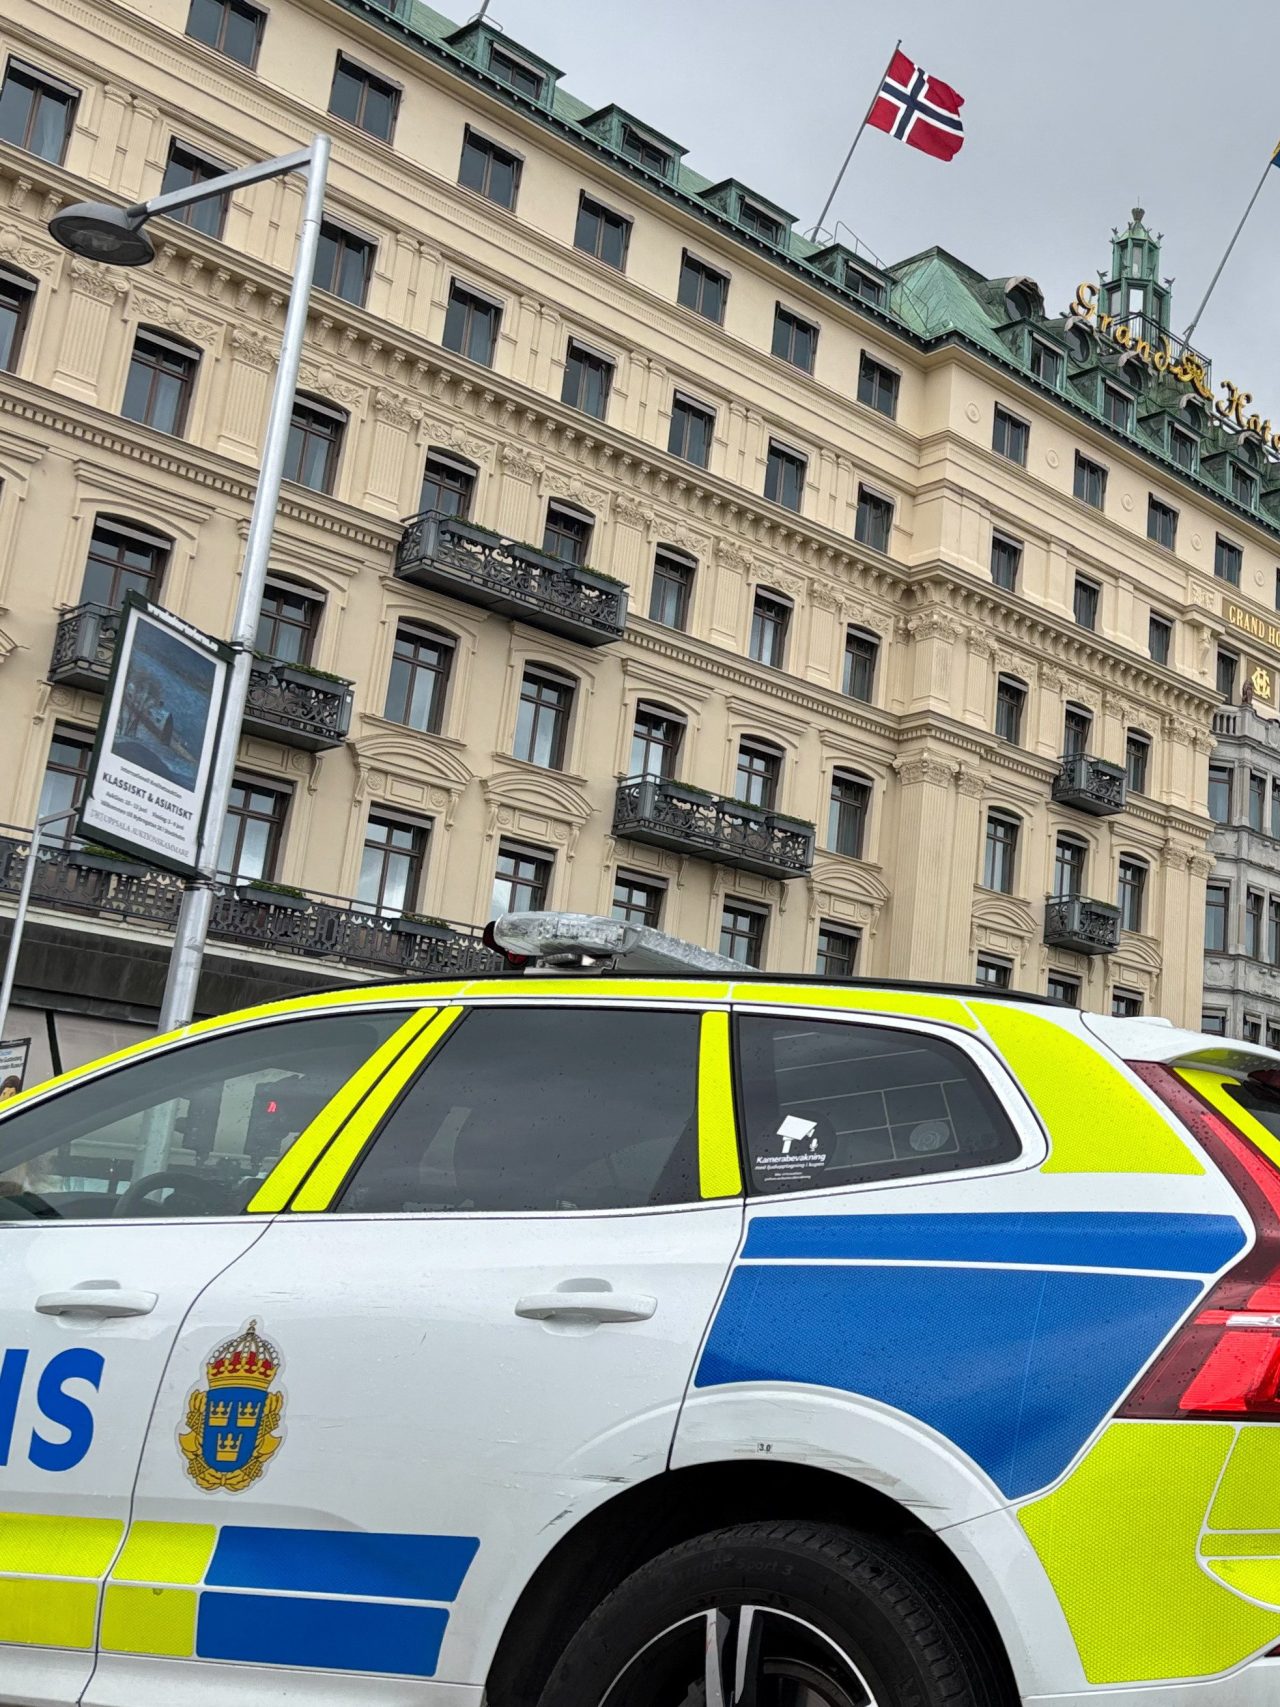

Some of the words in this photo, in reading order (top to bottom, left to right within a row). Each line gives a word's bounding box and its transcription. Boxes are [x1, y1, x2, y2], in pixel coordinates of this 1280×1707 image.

[1070, 282, 1172, 371] Grand
[1229, 606, 1265, 639] GRAND
[102, 772, 147, 800] KLASSISKT
[147, 792, 154, 802] &
[155, 796, 194, 821] ASIATISKT
[756, 1154, 827, 1164] Kamerabevakning
